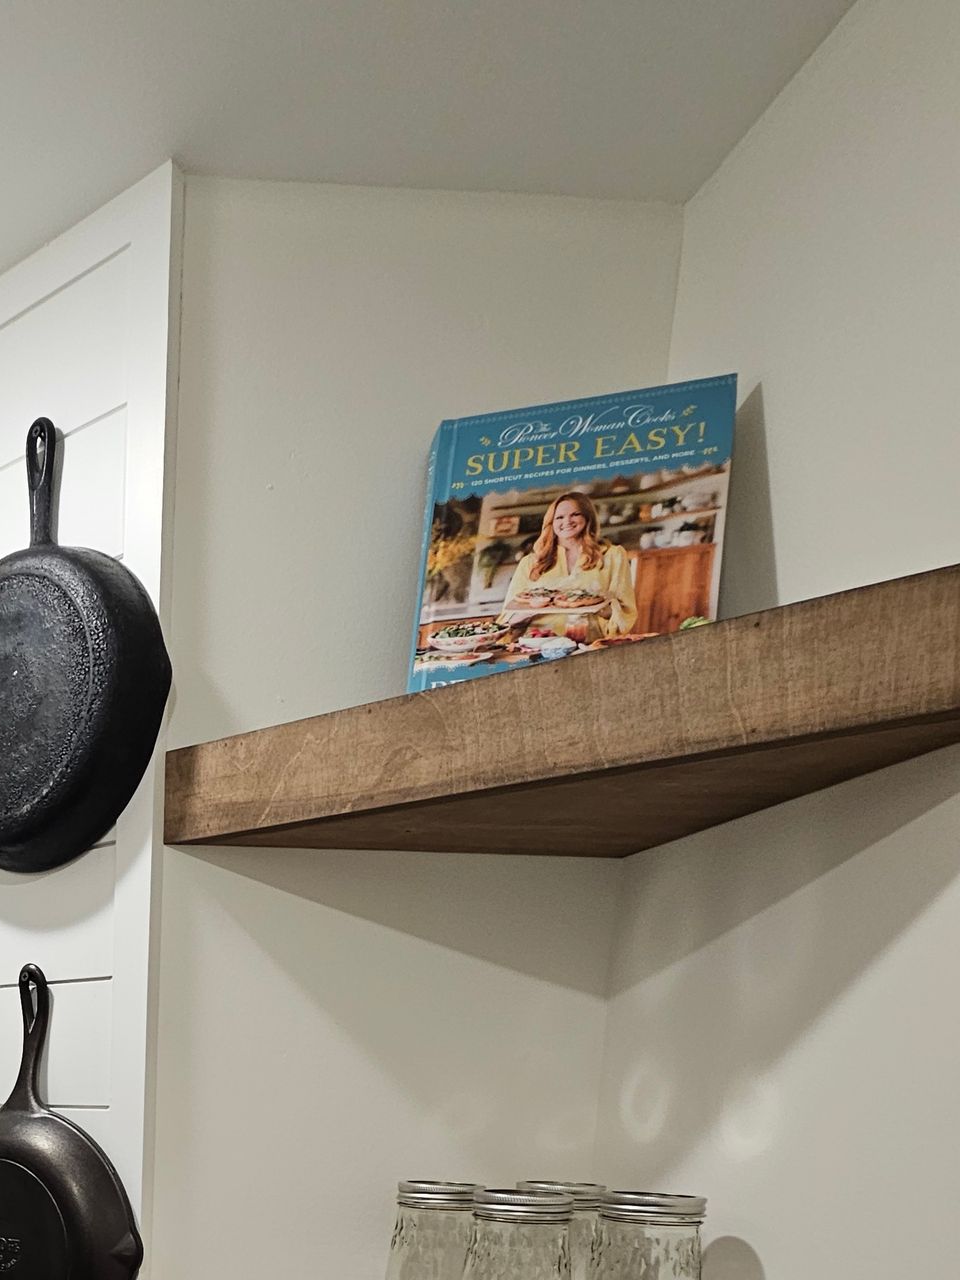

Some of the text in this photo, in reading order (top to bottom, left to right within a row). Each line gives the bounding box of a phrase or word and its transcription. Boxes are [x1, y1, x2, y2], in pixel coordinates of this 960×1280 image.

[497, 421, 559, 448] Pioneer
[559, 406, 626, 438] Woman
[464, 421, 706, 476] SUPER EASY!
[484, 474, 522, 485] SHORTCUT
[523, 470, 555, 479] RECIPES
[555, 467, 572, 475] FOR
[652, 453, 670, 462] AND
[671, 449, 695, 459] MORE
